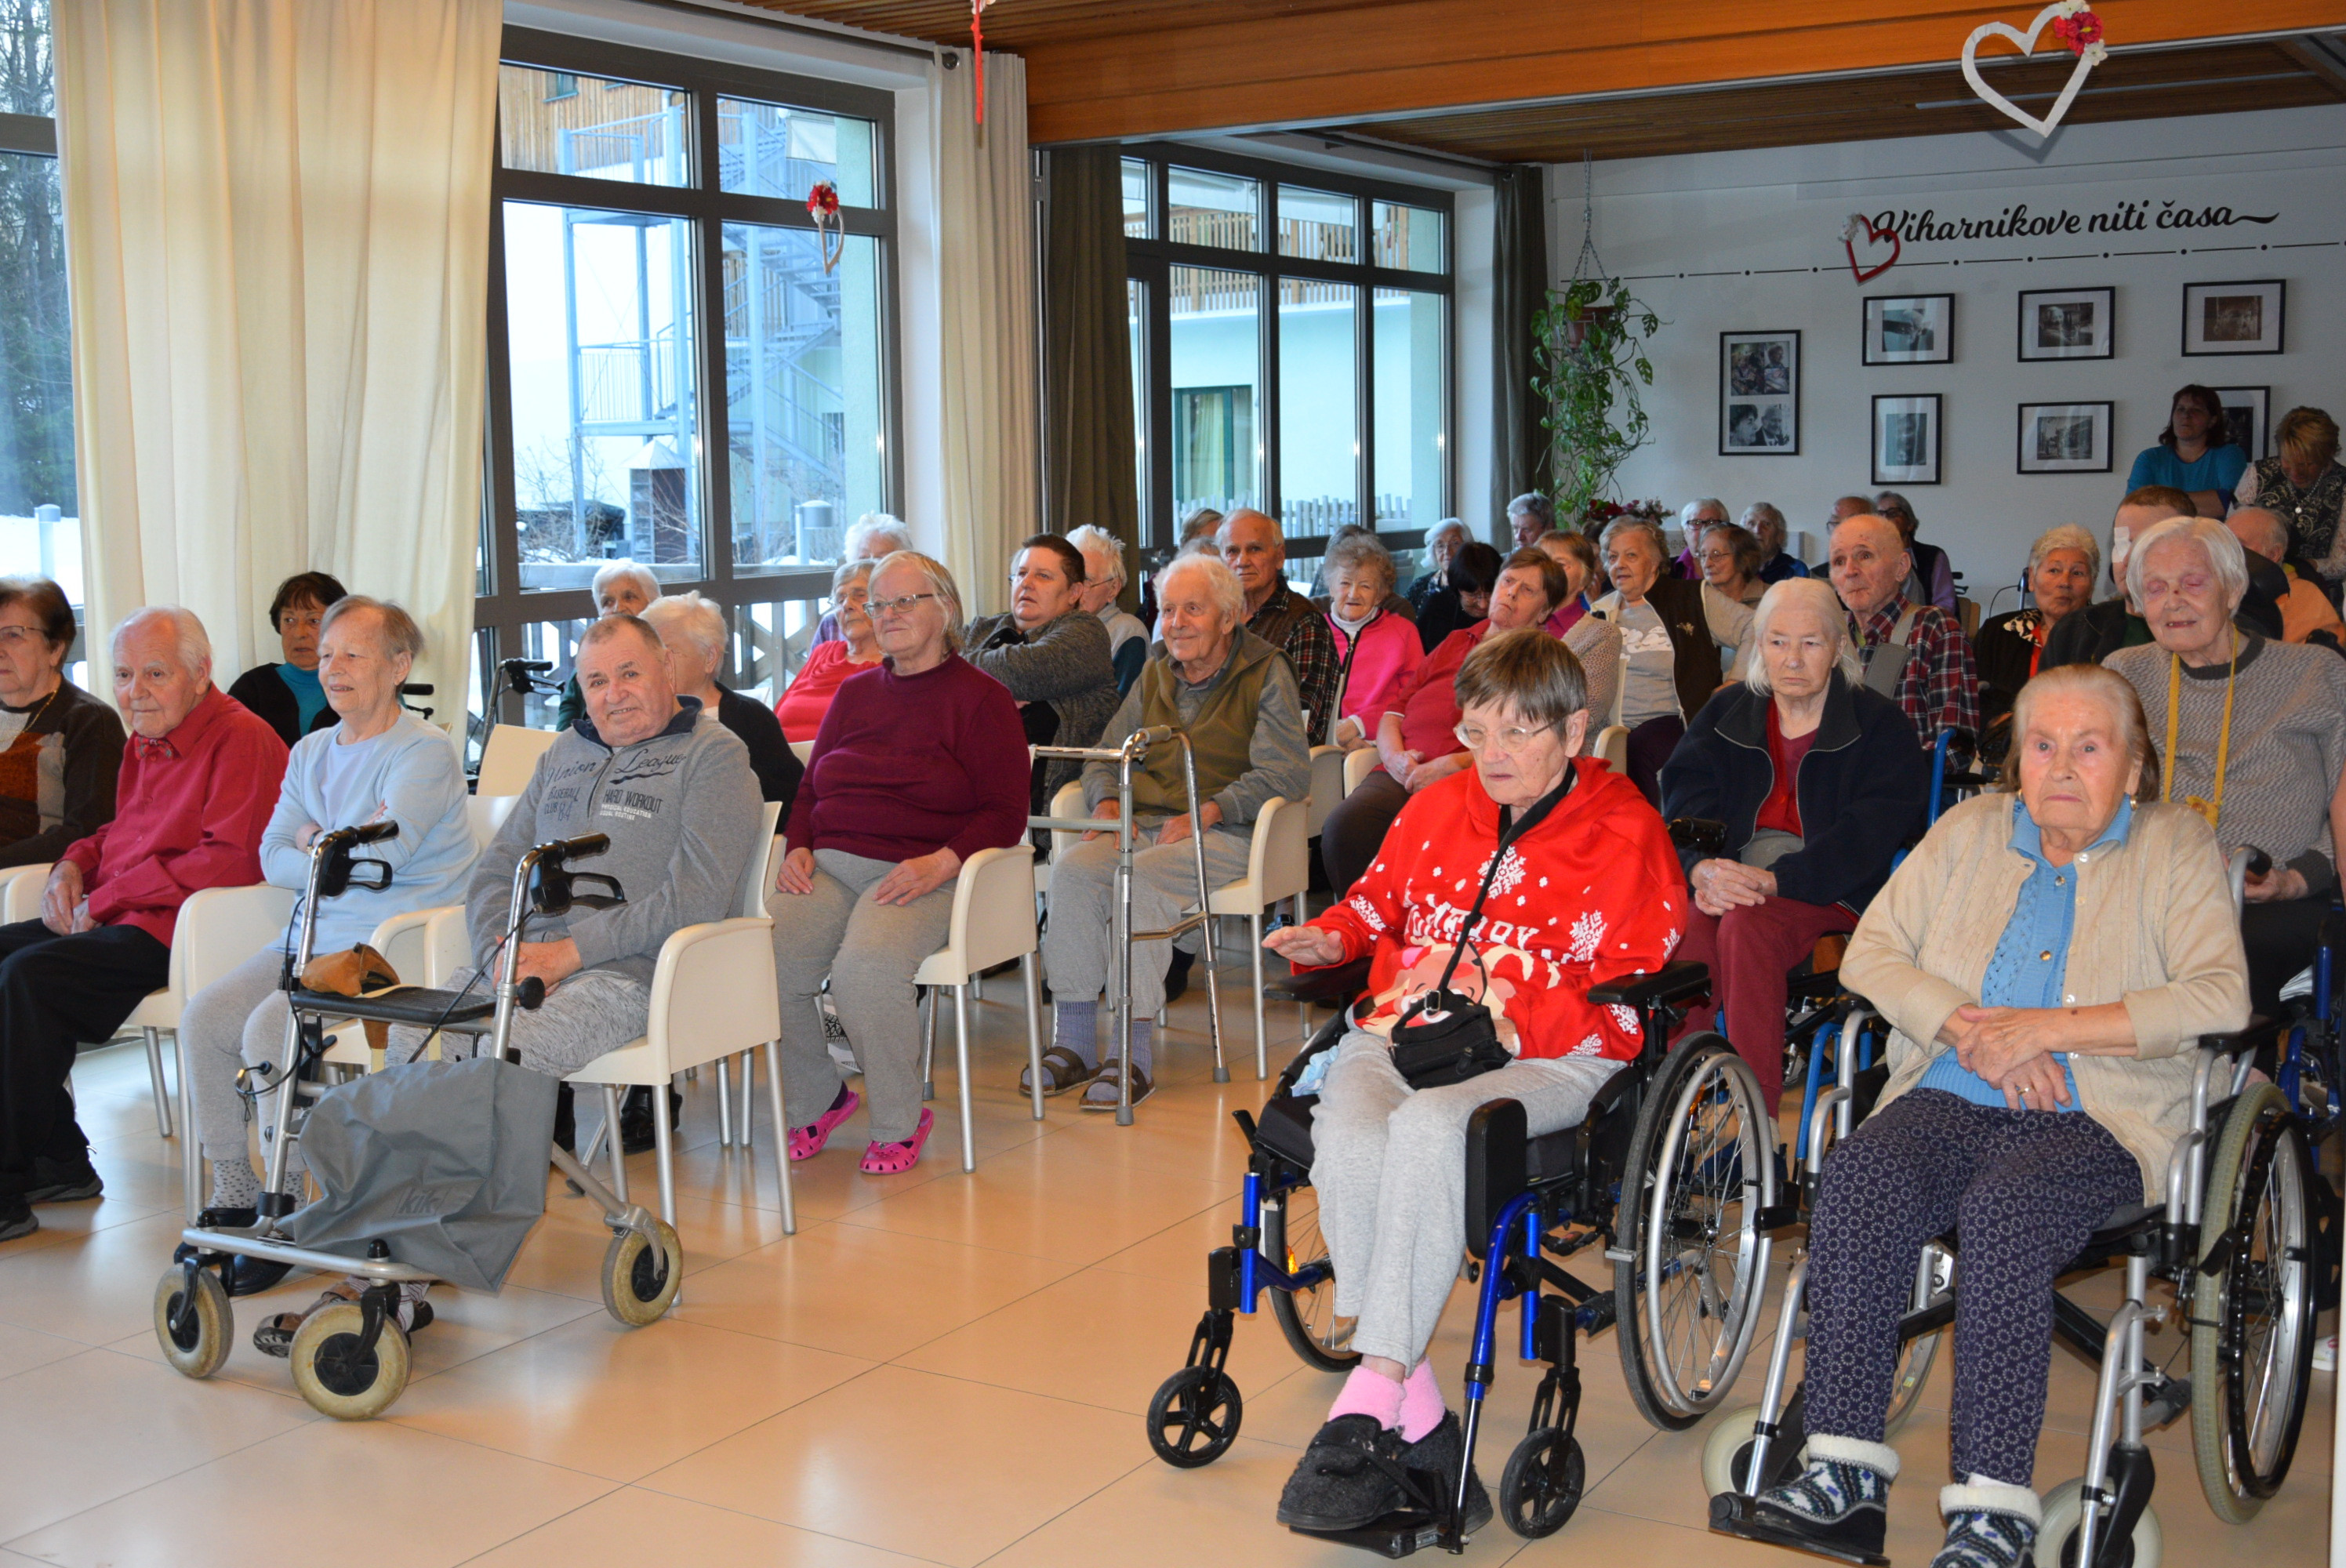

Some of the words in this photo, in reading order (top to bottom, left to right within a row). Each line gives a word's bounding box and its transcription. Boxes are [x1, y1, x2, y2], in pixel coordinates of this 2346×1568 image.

[1872, 204, 2082, 243] Viharnikove
[2087, 199, 2148, 233] niti
[2155, 199, 2279, 229] časa
[547, 760, 596, 784] Union
[614, 748, 687, 775] League
[603, 789, 624, 804] HARD
[625, 790, 664, 814] WORKOUT
